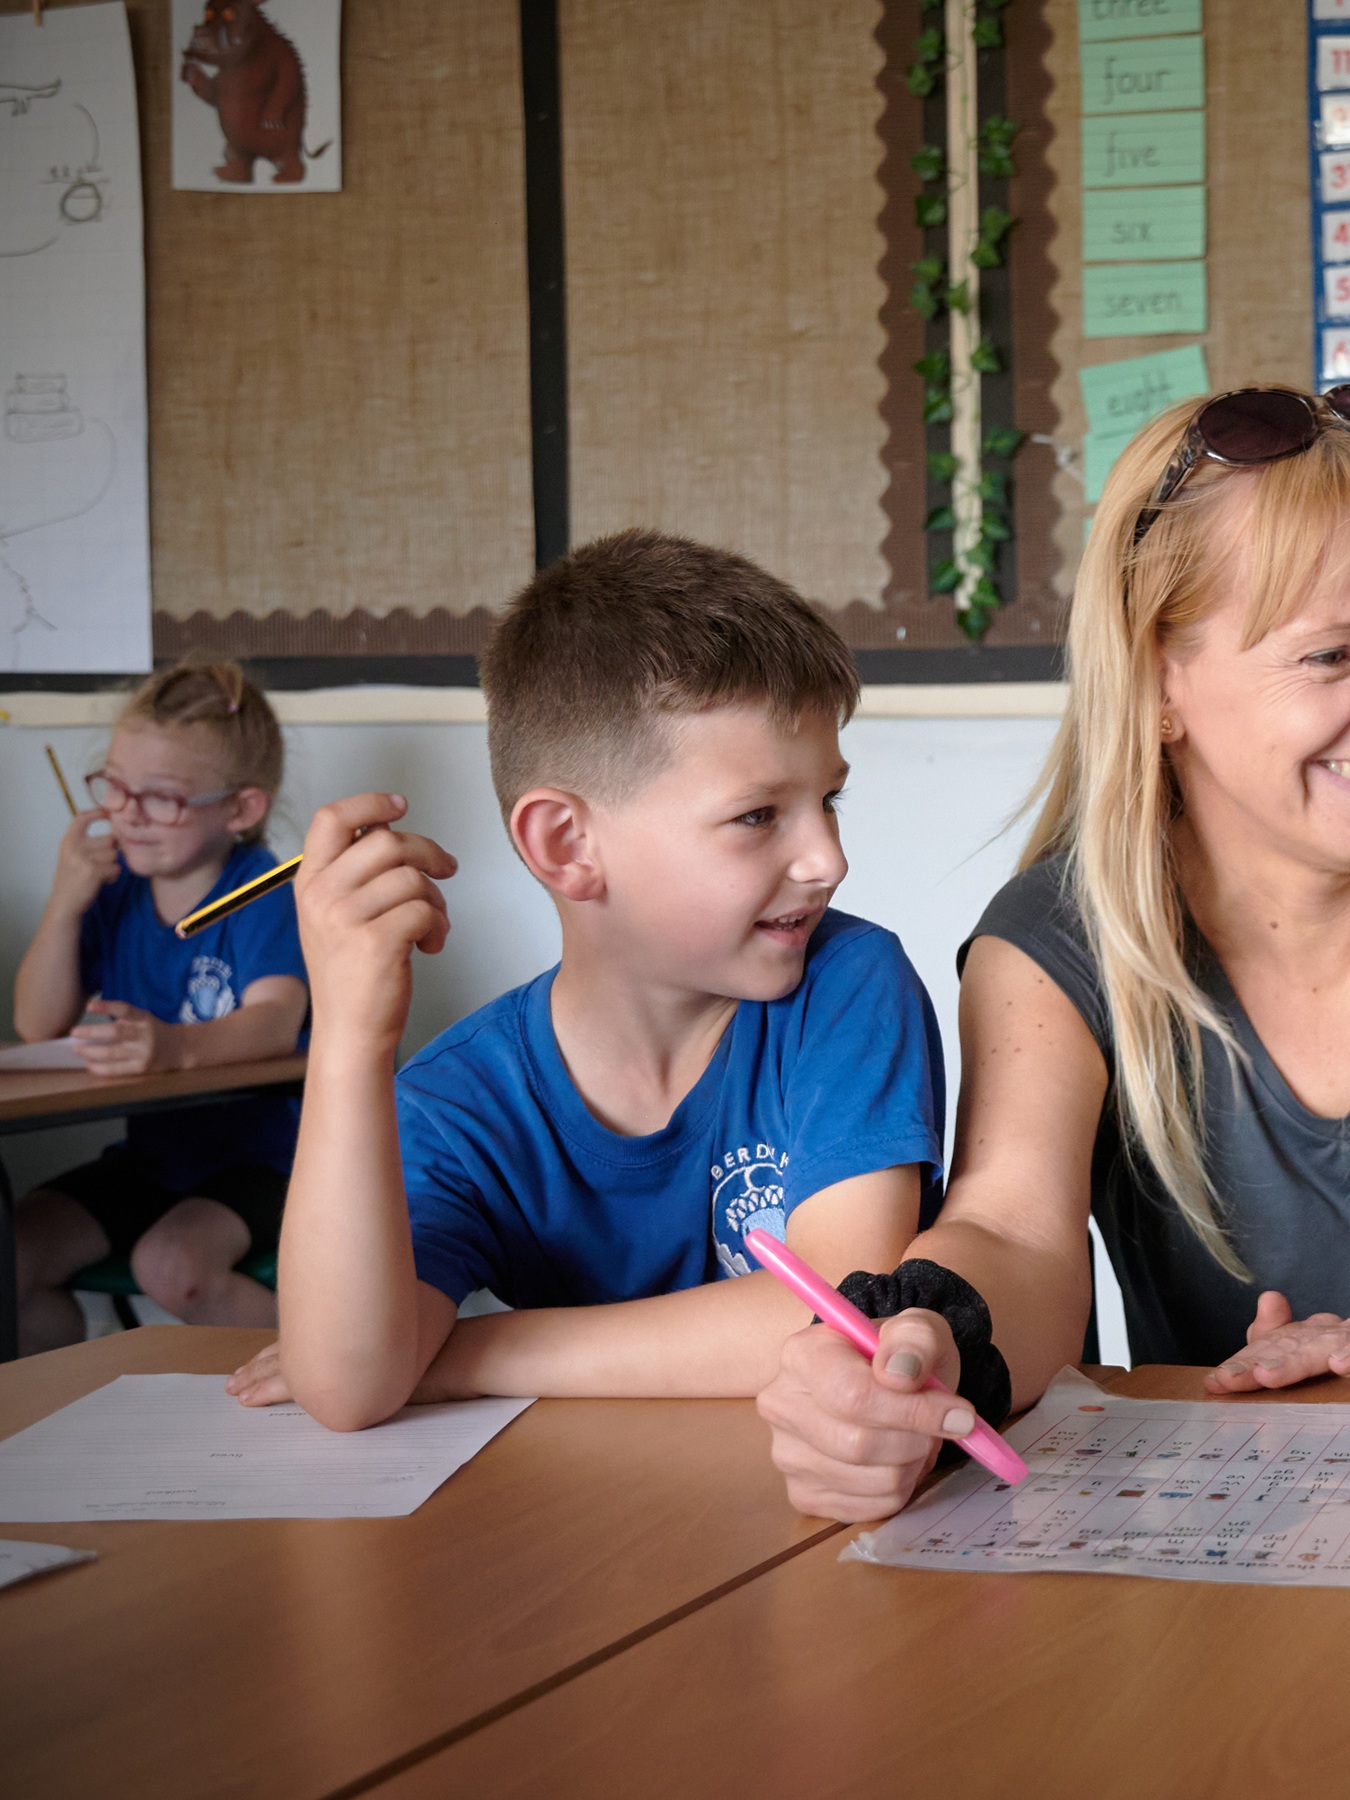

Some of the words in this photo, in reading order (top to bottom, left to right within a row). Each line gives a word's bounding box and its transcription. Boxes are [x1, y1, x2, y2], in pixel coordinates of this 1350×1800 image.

[1103, 56, 1173, 105] four
[1104, 131, 1161, 177] five
[1110, 220, 1153, 245] six
[1102, 288, 1182, 319] seven
